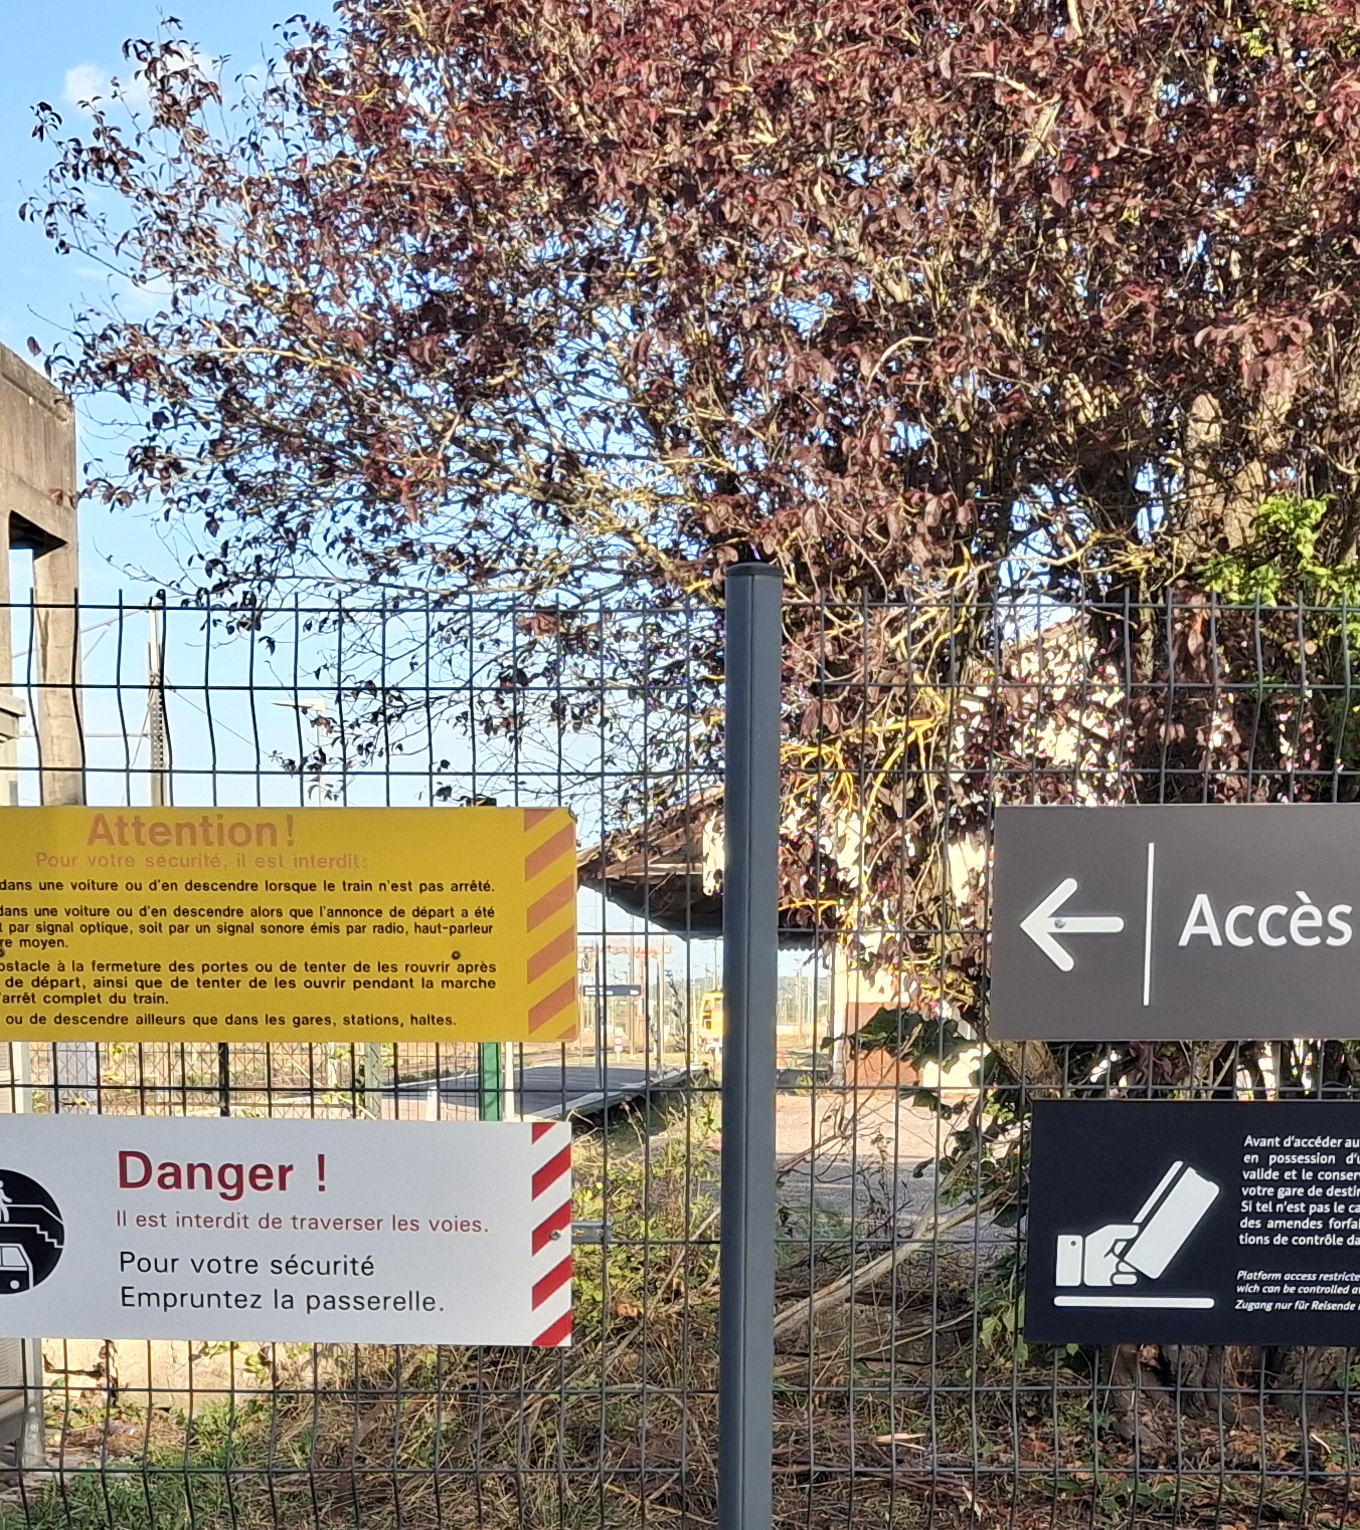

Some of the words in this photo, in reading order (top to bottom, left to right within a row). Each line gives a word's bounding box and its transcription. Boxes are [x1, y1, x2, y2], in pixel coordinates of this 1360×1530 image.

[36, 852, 78, 867] Pour
[88, 855, 135, 867] votre
[145, 853, 227, 871] sécurité,
[237, 854, 246, 868] il
[253, 856, 283, 868] est
[38, 881, 63, 890] une
[69, 878, 118, 891] voiture
[124, 881, 142, 891] ou
[148, 878, 177, 891] d'en
[184, 878, 258, 891] descendre
[264, 879, 316, 893] lorsque
[323, 879, 335, 891] le
[341, 879, 372, 891] train
[378, 879, 412, 891] n'est
[418, 882, 443, 894] pas
[450, 879, 495, 892] arrêté.
[1178, 890, 1352, 946] Accès
[57, 959, 65, 972] à
[71, 959, 83, 972] la
[91, 959, 161, 972] fermeture
[168, 959, 194, 972] des
[201, 960, 247, 975] portes
[255, 962, 272, 972] ou
[279, 959, 297, 972] de
[303, 960, 346, 972] tenter
[353, 959, 370, 972] de
[377, 960, 397, 973] les
[404, 960, 450, 972] rouvrir
[456, 959, 496, 975] après
[4, 976, 24, 988] de
[30, 975, 86, 992] départ,
[92, 975, 127, 993] ainsi
[134, 978, 162, 993] que
[169, 975, 188, 988] de
[195, 976, 241, 988] tenter
[248, 975, 267, 988] de
[273, 975, 296, 988] les
[303, 975, 346, 988] ouvrir
[352, 976, 414, 991] pendant
[421, 976, 433, 989] la
[440, 976, 496, 989] marche
[42, 991, 102, 1006] complet
[108, 991, 126, 1004] du
[132, 991, 168, 1004] train.
[5, 1015, 22, 1024] ou
[29, 1011, 46, 1024] de
[53, 1012, 128, 1025] descendre
[135, 1012, 185, 1025] ailleurs
[192, 1015, 217, 1027] que
[224, 1013, 258, 1025] dans
[264, 1013, 285, 1025] les
[292, 1016, 336, 1028] gares,
[342, 1013, 403, 1028] stations,
[409, 1013, 456, 1025] haltes.
[1243, 1134, 1280, 1147] Avant
[1283, 1135, 1342, 1147] d'accéder
[1243, 1154, 1258, 1163] en
[1268, 1151, 1335, 1166] possession
[118, 1150, 293, 1202] Danger
[1242, 1167, 1279, 1179] valide
[1283, 1169, 1297, 1180] et
[1301, 1168, 1313, 1180] le
[1241, 1185, 1274, 1196] votre
[1277, 1187, 1304, 1199] gare
[1307, 1184, 1322, 1196] de
[1240, 1199, 1252, 1212] Si
[1255, 1200, 1272, 1212] tel
[1275, 1200, 1305, 1213] n'est
[1308, 1203, 1330, 1215] pas
[1333, 1201, 1345, 1213] le
[116, 1209, 126, 1226] Il
[135, 1212, 167, 1227] est
[175, 1210, 249, 1229] interdit
[257, 1212, 282, 1229] de
[290, 1215, 383, 1231] traverser
[392, 1214, 419, 1231] les
[428, 1214, 487, 1232] voies.
[1239, 1216, 1261, 1228] des
[1266, 1217, 1323, 1229] amendes
[1238, 1232, 1270, 1244] tions
[1272, 1233, 1288, 1245] de
[1291, 1233, 1343, 1245] contrôle
[120, 1250, 179, 1273] Pour
[190, 1255, 258, 1274] votre
[270, 1253, 374, 1276] sécurité
[1236, 1283, 1260, 1292] wich
[1262, 1285, 1280, 1293] can
[1282, 1283, 1296, 1293] be
[1297, 1284, 1350, 1294] controlled
[121, 1285, 261, 1313] Empruntez
[274, 1288, 293, 1309] la
[306, 1289, 443, 1315] passerelle.
[1234, 1299, 1273, 1311] Zugang
[1294, 1300, 1309, 1310] für
[1310, 1300, 1355, 1310] Reisende
